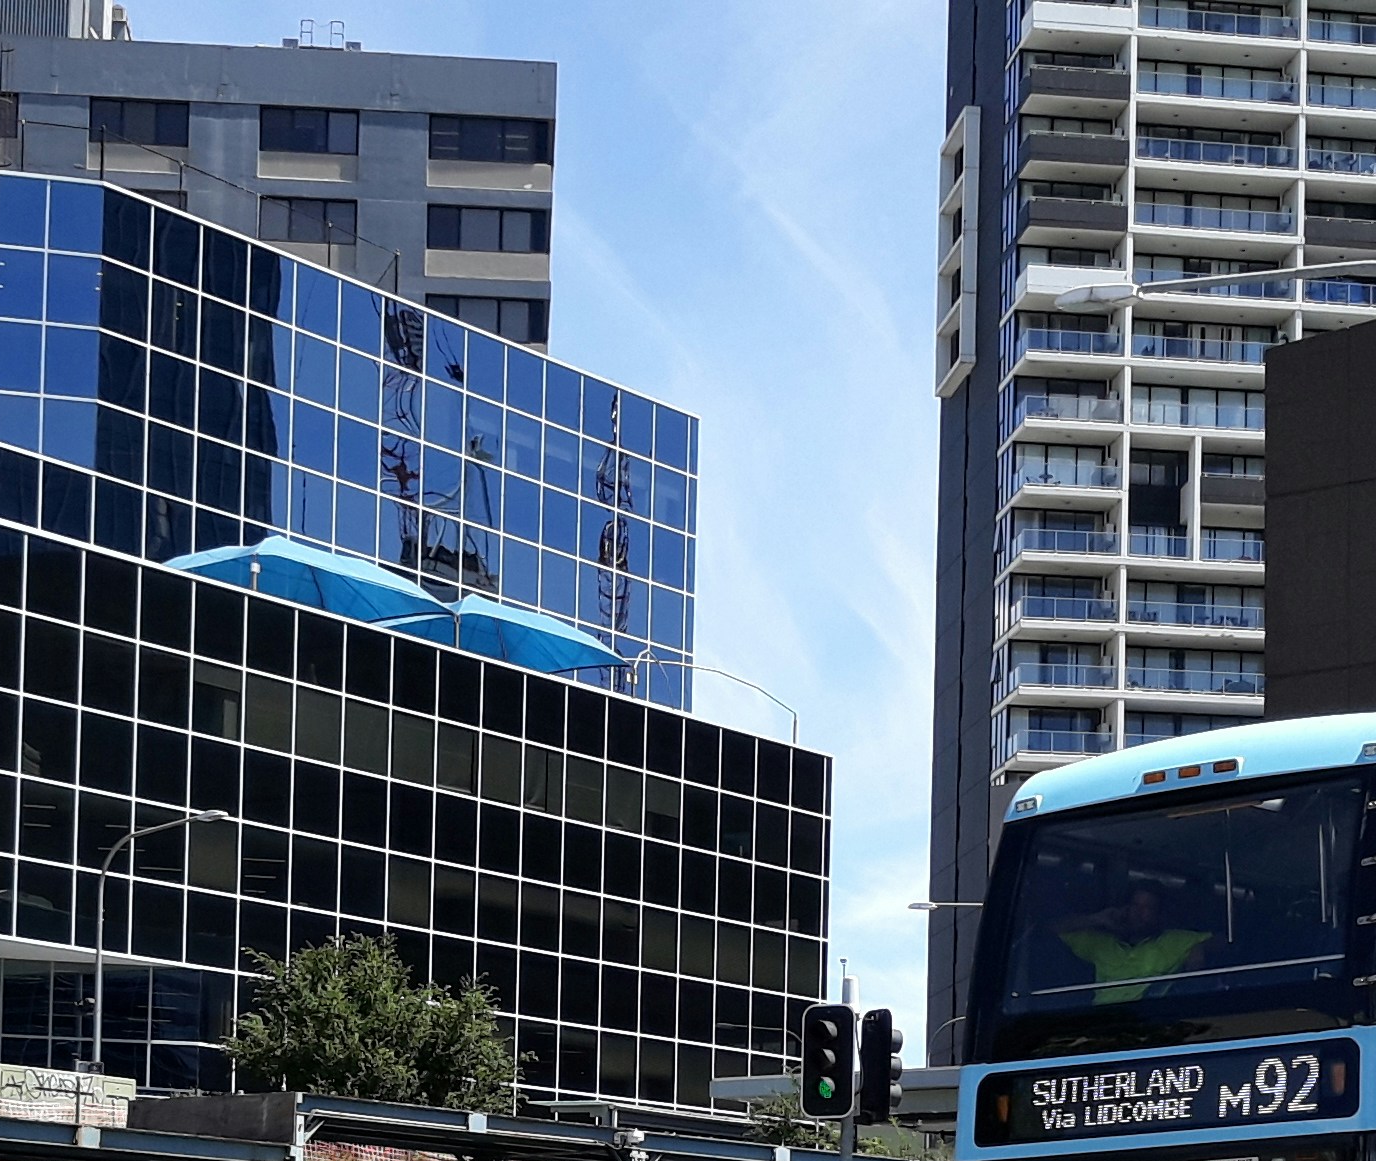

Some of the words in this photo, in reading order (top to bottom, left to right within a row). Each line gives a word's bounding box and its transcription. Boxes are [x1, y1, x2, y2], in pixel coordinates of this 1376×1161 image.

[1032, 1065, 1205, 1106] SUTHERLAND
[1041, 1108, 1076, 1129] Via
[1084, 1098, 1193, 1126] LIDCOMBE
